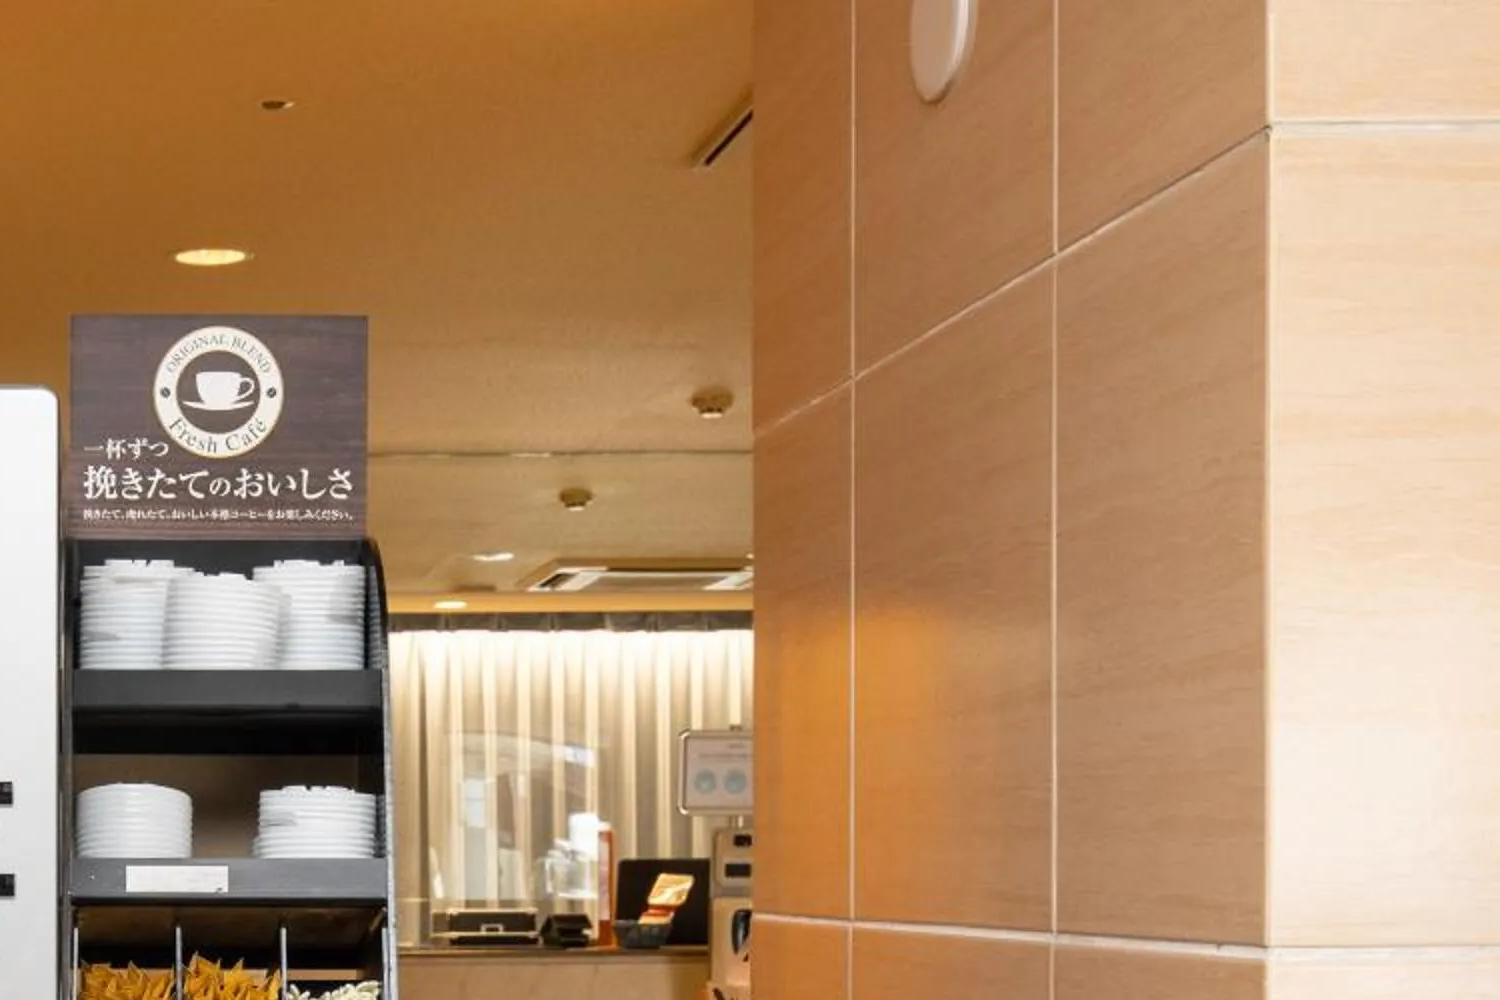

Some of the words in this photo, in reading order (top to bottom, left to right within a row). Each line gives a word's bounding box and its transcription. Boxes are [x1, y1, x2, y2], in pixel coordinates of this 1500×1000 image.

[166, 334, 225, 373] ORIGINAL
[230, 335, 271, 373] BLEND
[83, 437, 170, 460] 一杯ずつ
[169, 418, 217, 453] Fresh
[83, 465, 353, 500] 挽きたてのおいしさ
